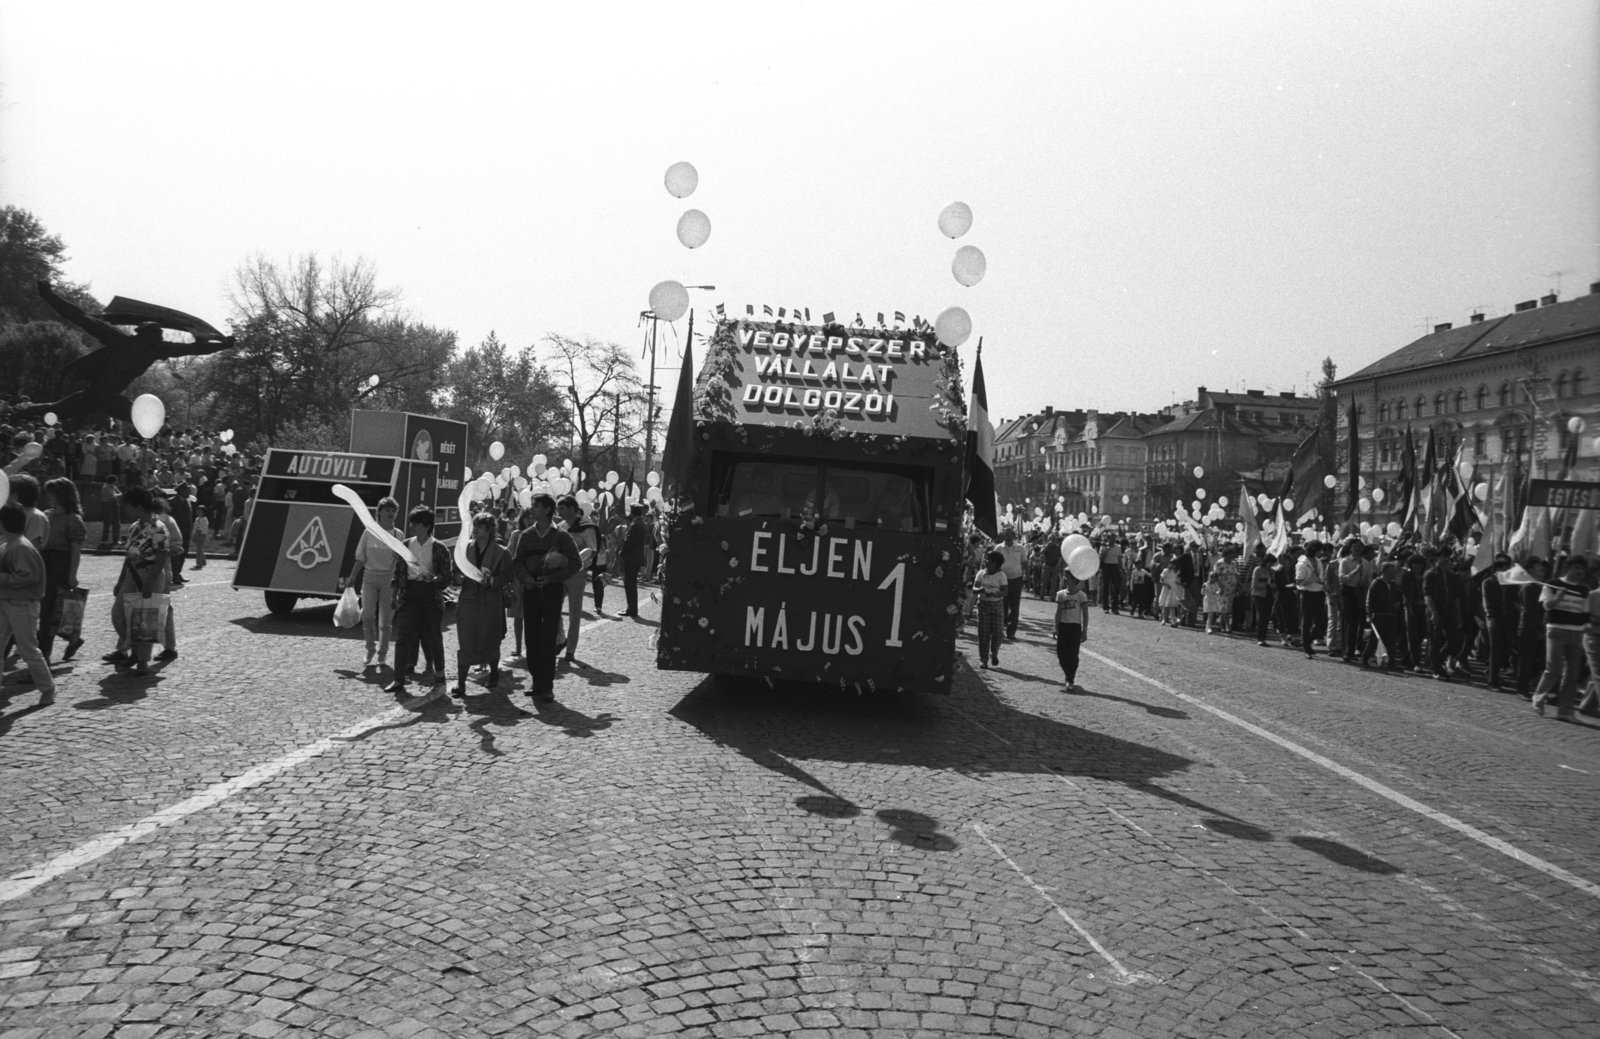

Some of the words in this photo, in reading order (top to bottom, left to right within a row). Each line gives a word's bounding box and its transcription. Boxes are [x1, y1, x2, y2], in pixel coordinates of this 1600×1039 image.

[739, 330, 926, 359] VEGYÉPSZER
[755, 354, 893, 384] VÁLLALAT
[742, 384, 894, 415] DOLGOZÓI
[287, 453, 368, 478] AUTÓVILL
[751, 521, 873, 581] ÉLJEN
[877, 563, 906, 647] 1
[744, 602, 866, 656] MÁJUS
